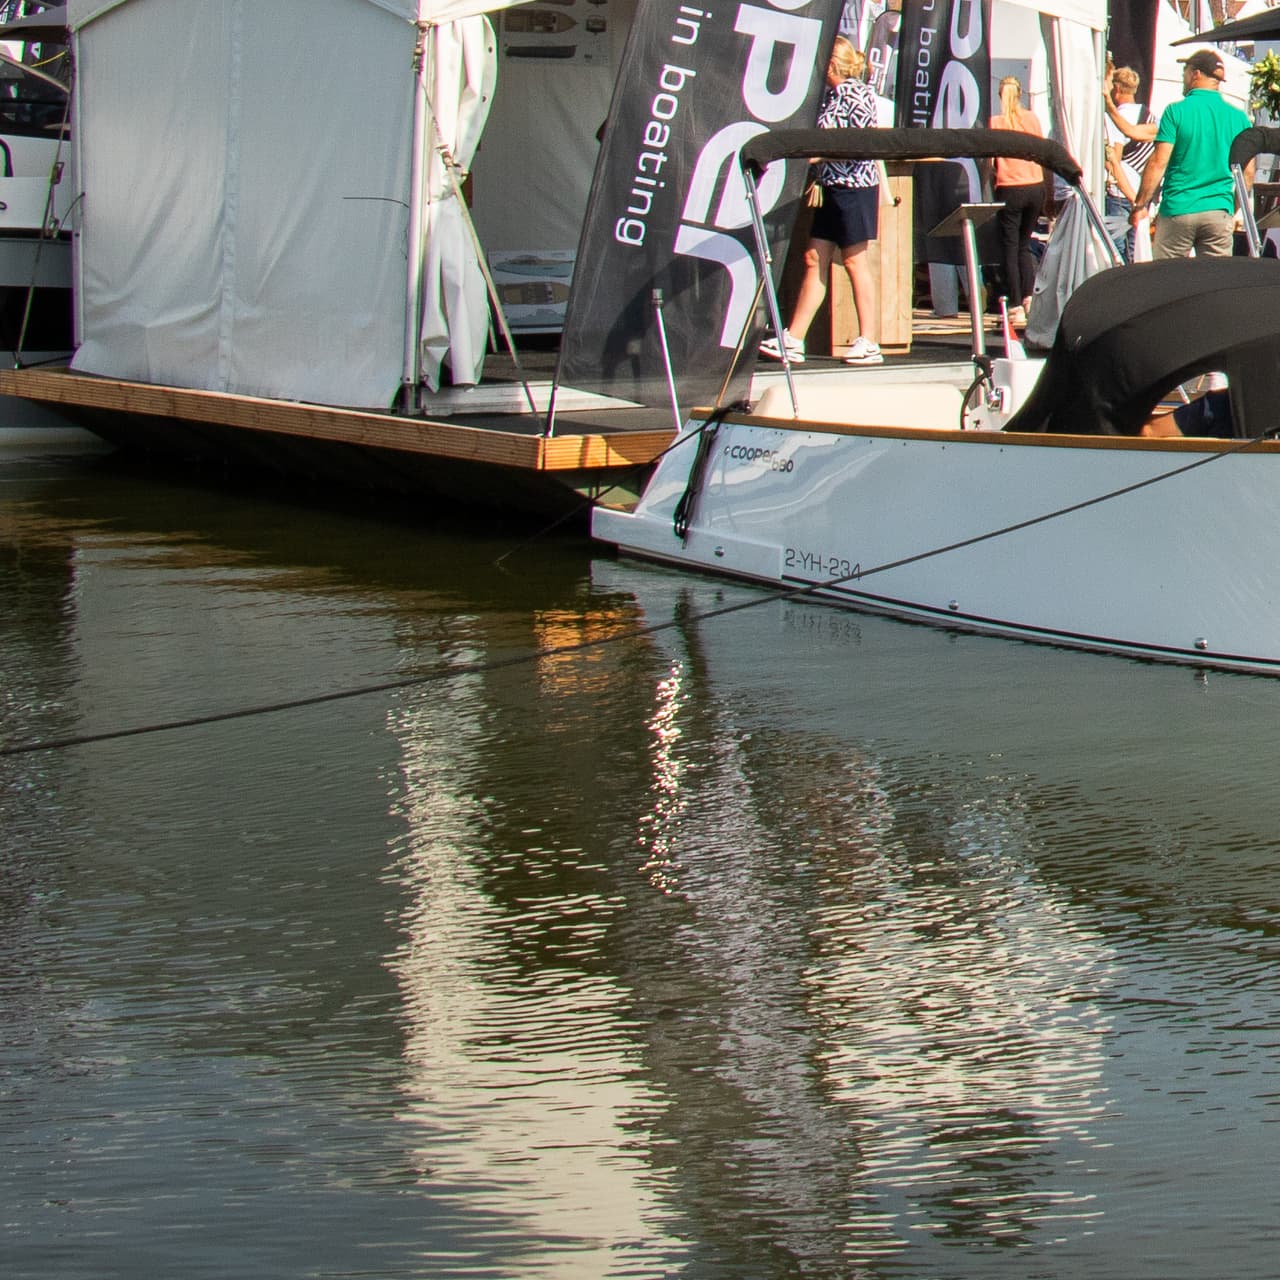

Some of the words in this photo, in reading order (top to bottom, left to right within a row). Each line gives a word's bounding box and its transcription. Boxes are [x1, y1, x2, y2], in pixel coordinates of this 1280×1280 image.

[672, 6, 713, 46] in
[615, 64, 698, 248] boating
[785, 548, 862, 582] 2-YH-234
